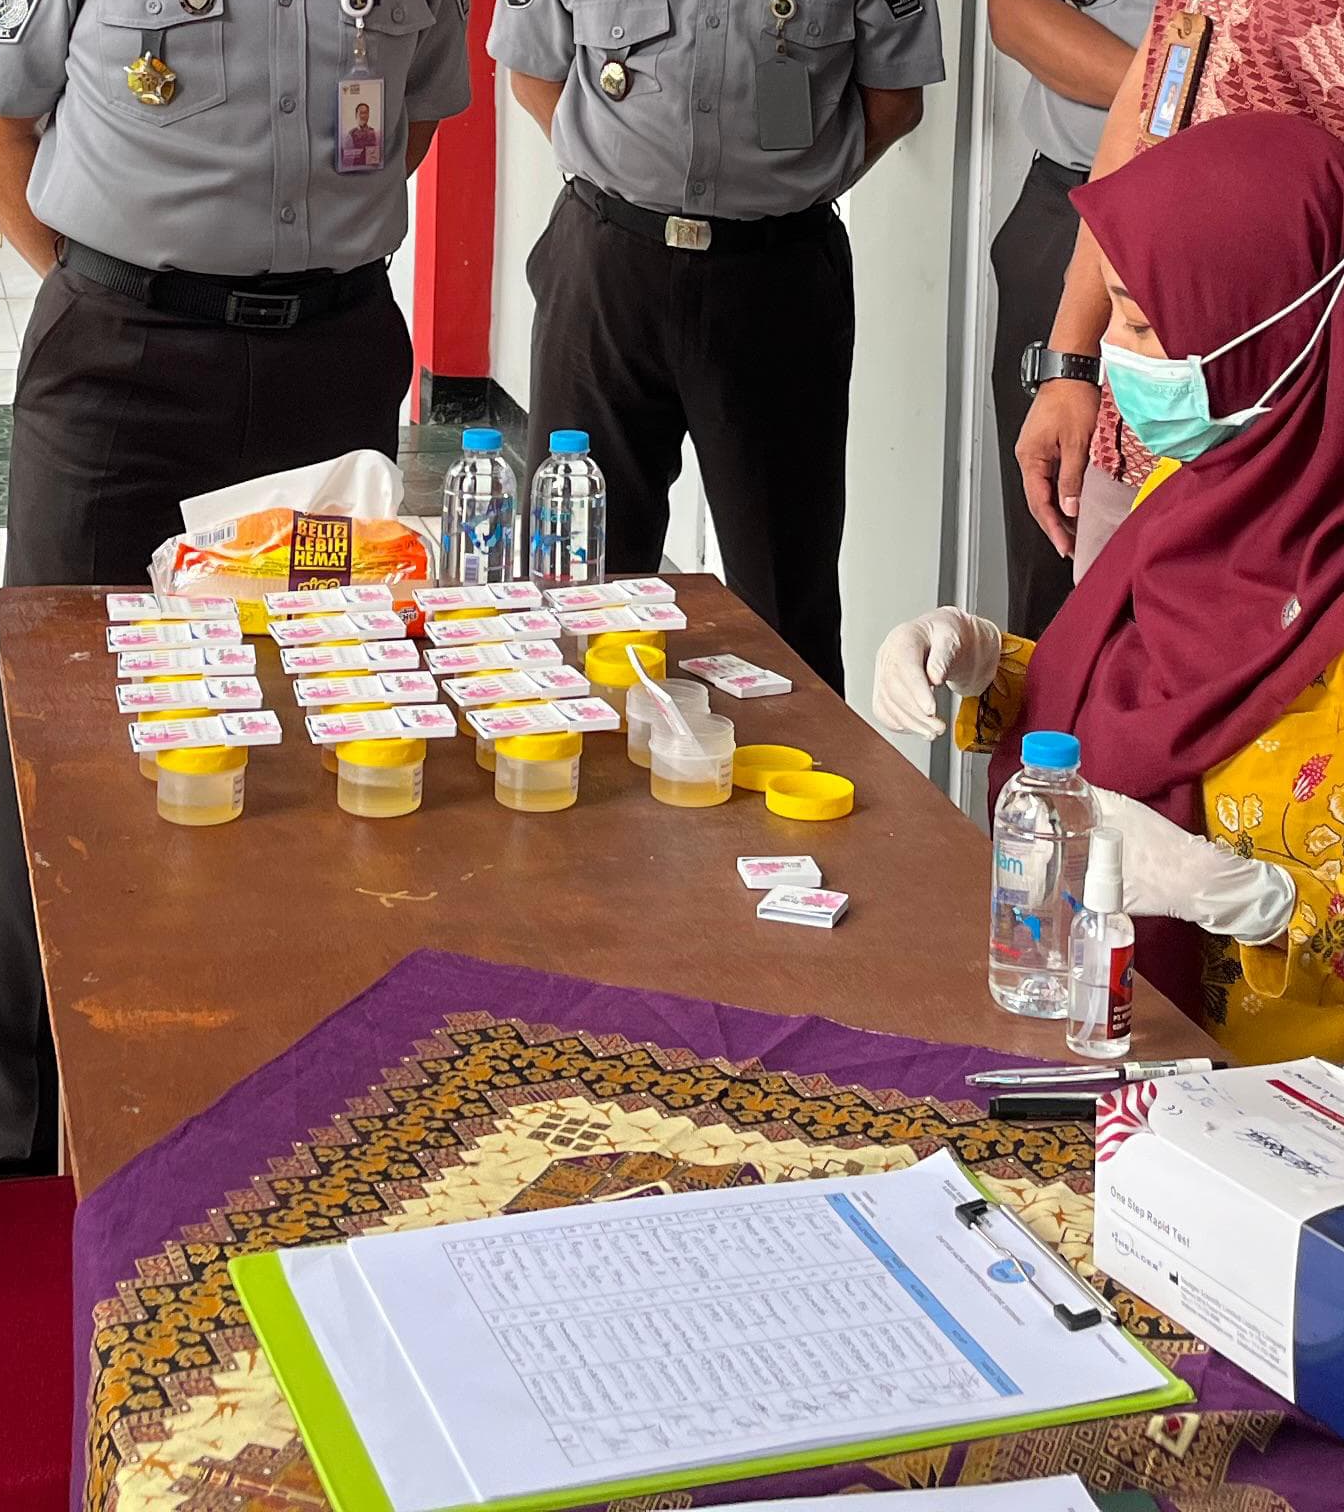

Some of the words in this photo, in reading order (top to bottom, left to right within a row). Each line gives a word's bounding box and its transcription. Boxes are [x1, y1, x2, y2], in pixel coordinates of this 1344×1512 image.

[297, 521, 332, 537] BELI
[335, 525, 348, 538] 2
[296, 535, 348, 552] LEBIH
[294, 550, 347, 566] HEMAT
[1110, 1185, 1126, 1205] One
[1127, 1196, 1145, 1219] Step
[1147, 1210, 1170, 1234] Rapid
[1172, 1228, 1191, 1248] Test
